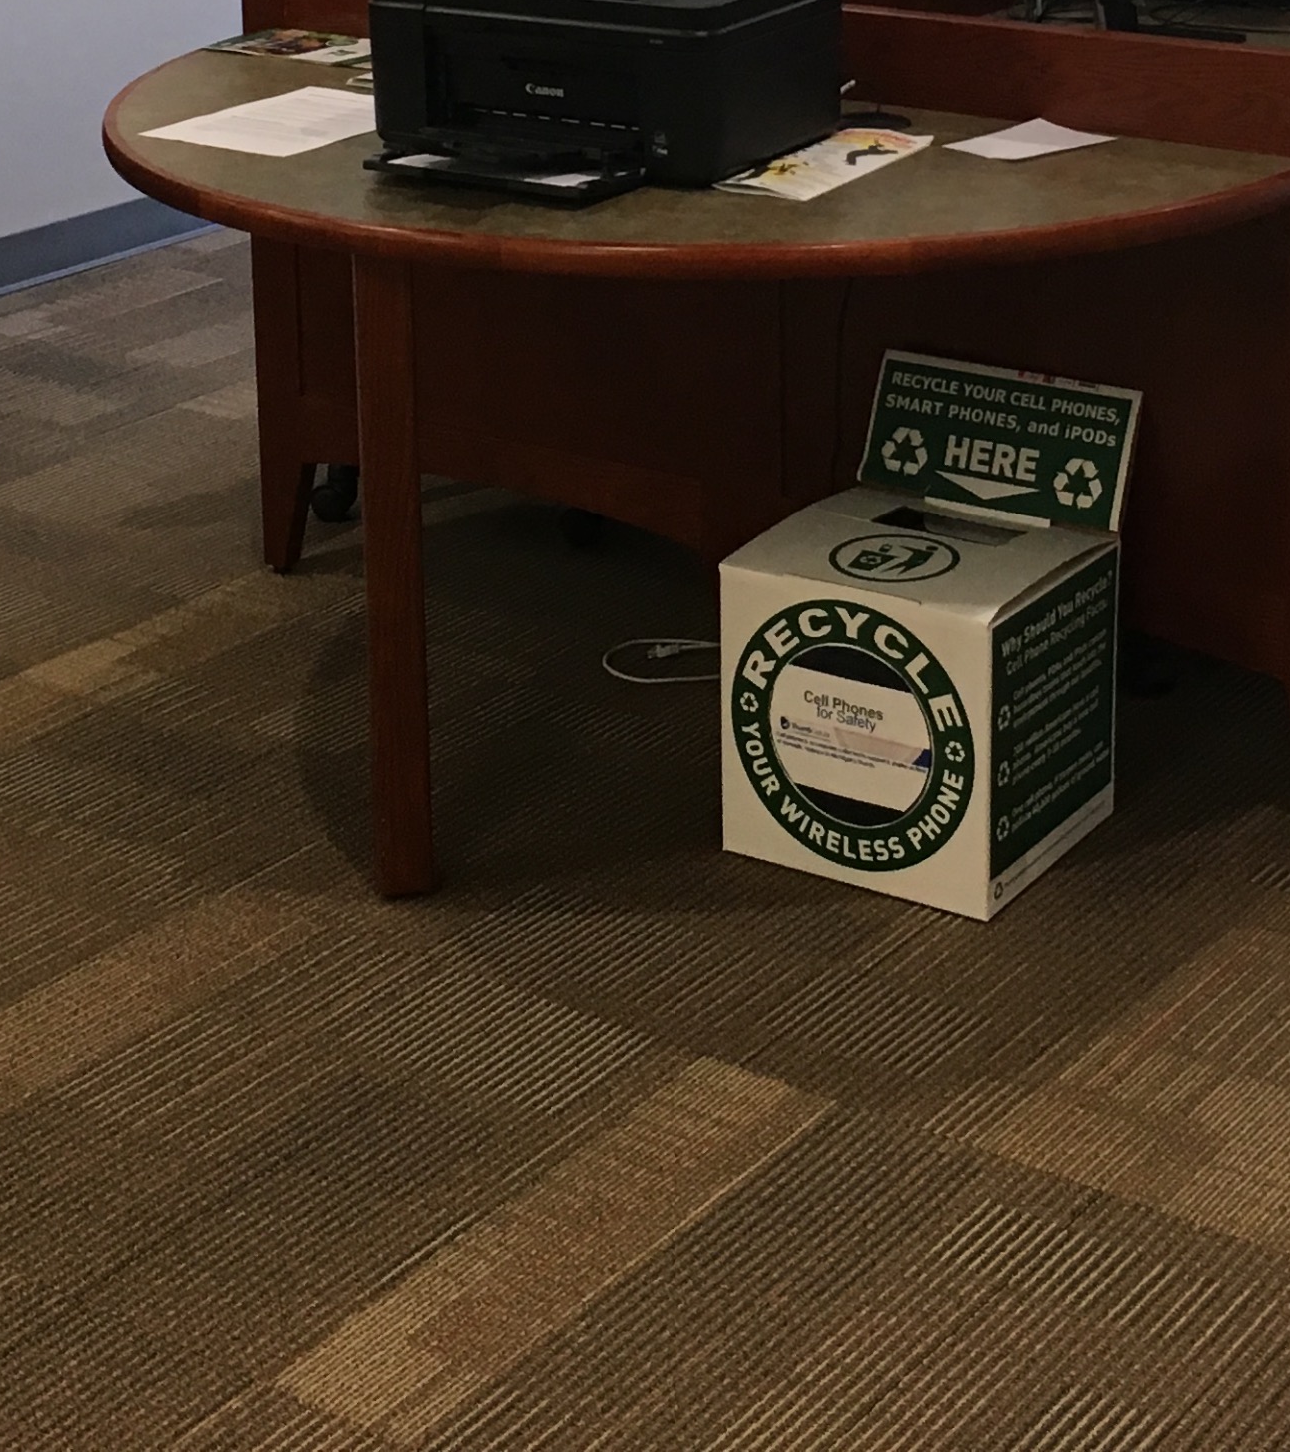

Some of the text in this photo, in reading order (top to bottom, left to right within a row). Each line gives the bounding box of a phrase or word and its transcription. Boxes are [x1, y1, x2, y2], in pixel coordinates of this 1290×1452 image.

[525, 83, 564, 98] Canon
[885, 394, 1117, 447] SMART PHONES, and iPODs
[892, 372, 1120, 425] RECYCLE YOUR CELL PHONES,
[944, 435, 1040, 481] HERE
[1023, 609, 1056, 643] Should
[742, 607, 963, 731] RECYCLE
[804, 690, 884, 720] Cell Phones
[817, 705, 876, 732] for Safety
[742, 722, 780, 796] YOUR
[779, 795, 905, 861] WIRELESS
[906, 769, 963, 850] PHONE
